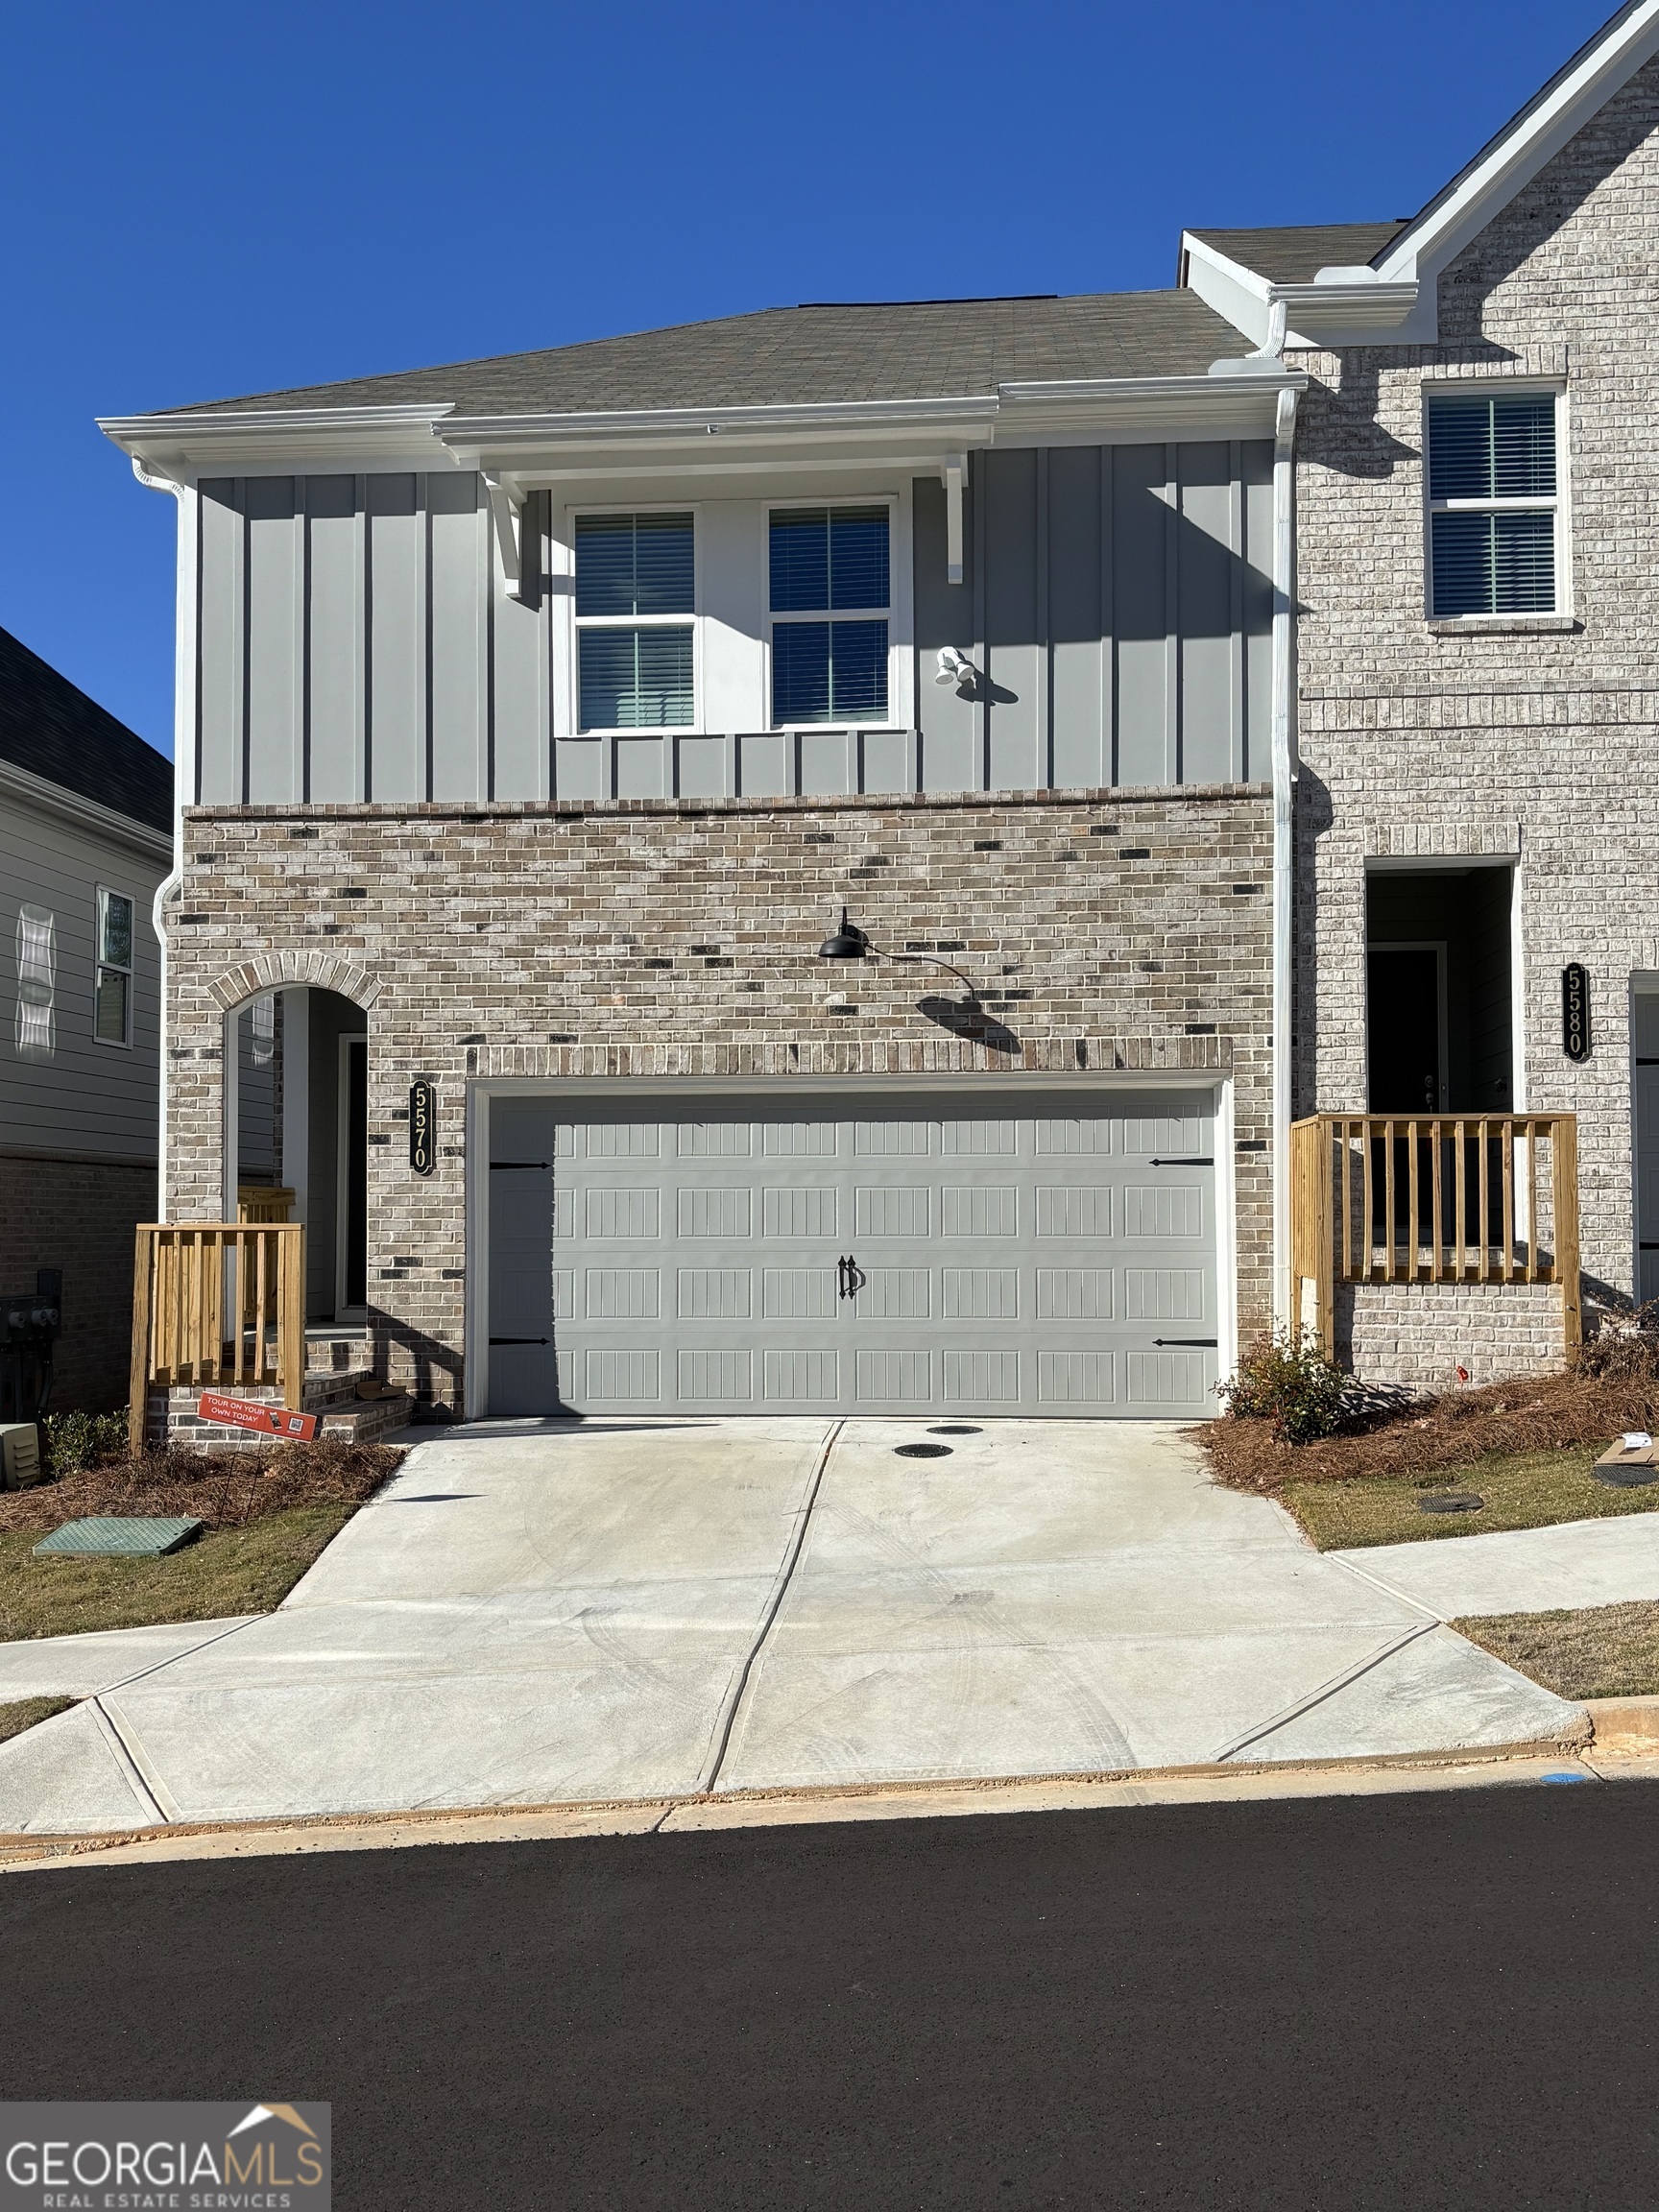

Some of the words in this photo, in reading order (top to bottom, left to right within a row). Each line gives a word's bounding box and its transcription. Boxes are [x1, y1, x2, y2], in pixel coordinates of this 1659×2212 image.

[1570, 970, 1581, 1053] 5580
[416, 1088, 426, 1167] 5570
[207, 1396, 228, 1407] TOUR
[230, 1402, 242, 1410] ON
[244, 1405, 265, 1416] YOUR
[211, 1407, 230, 1416] OWN
[232, 1411, 258, 1423] TODAY
